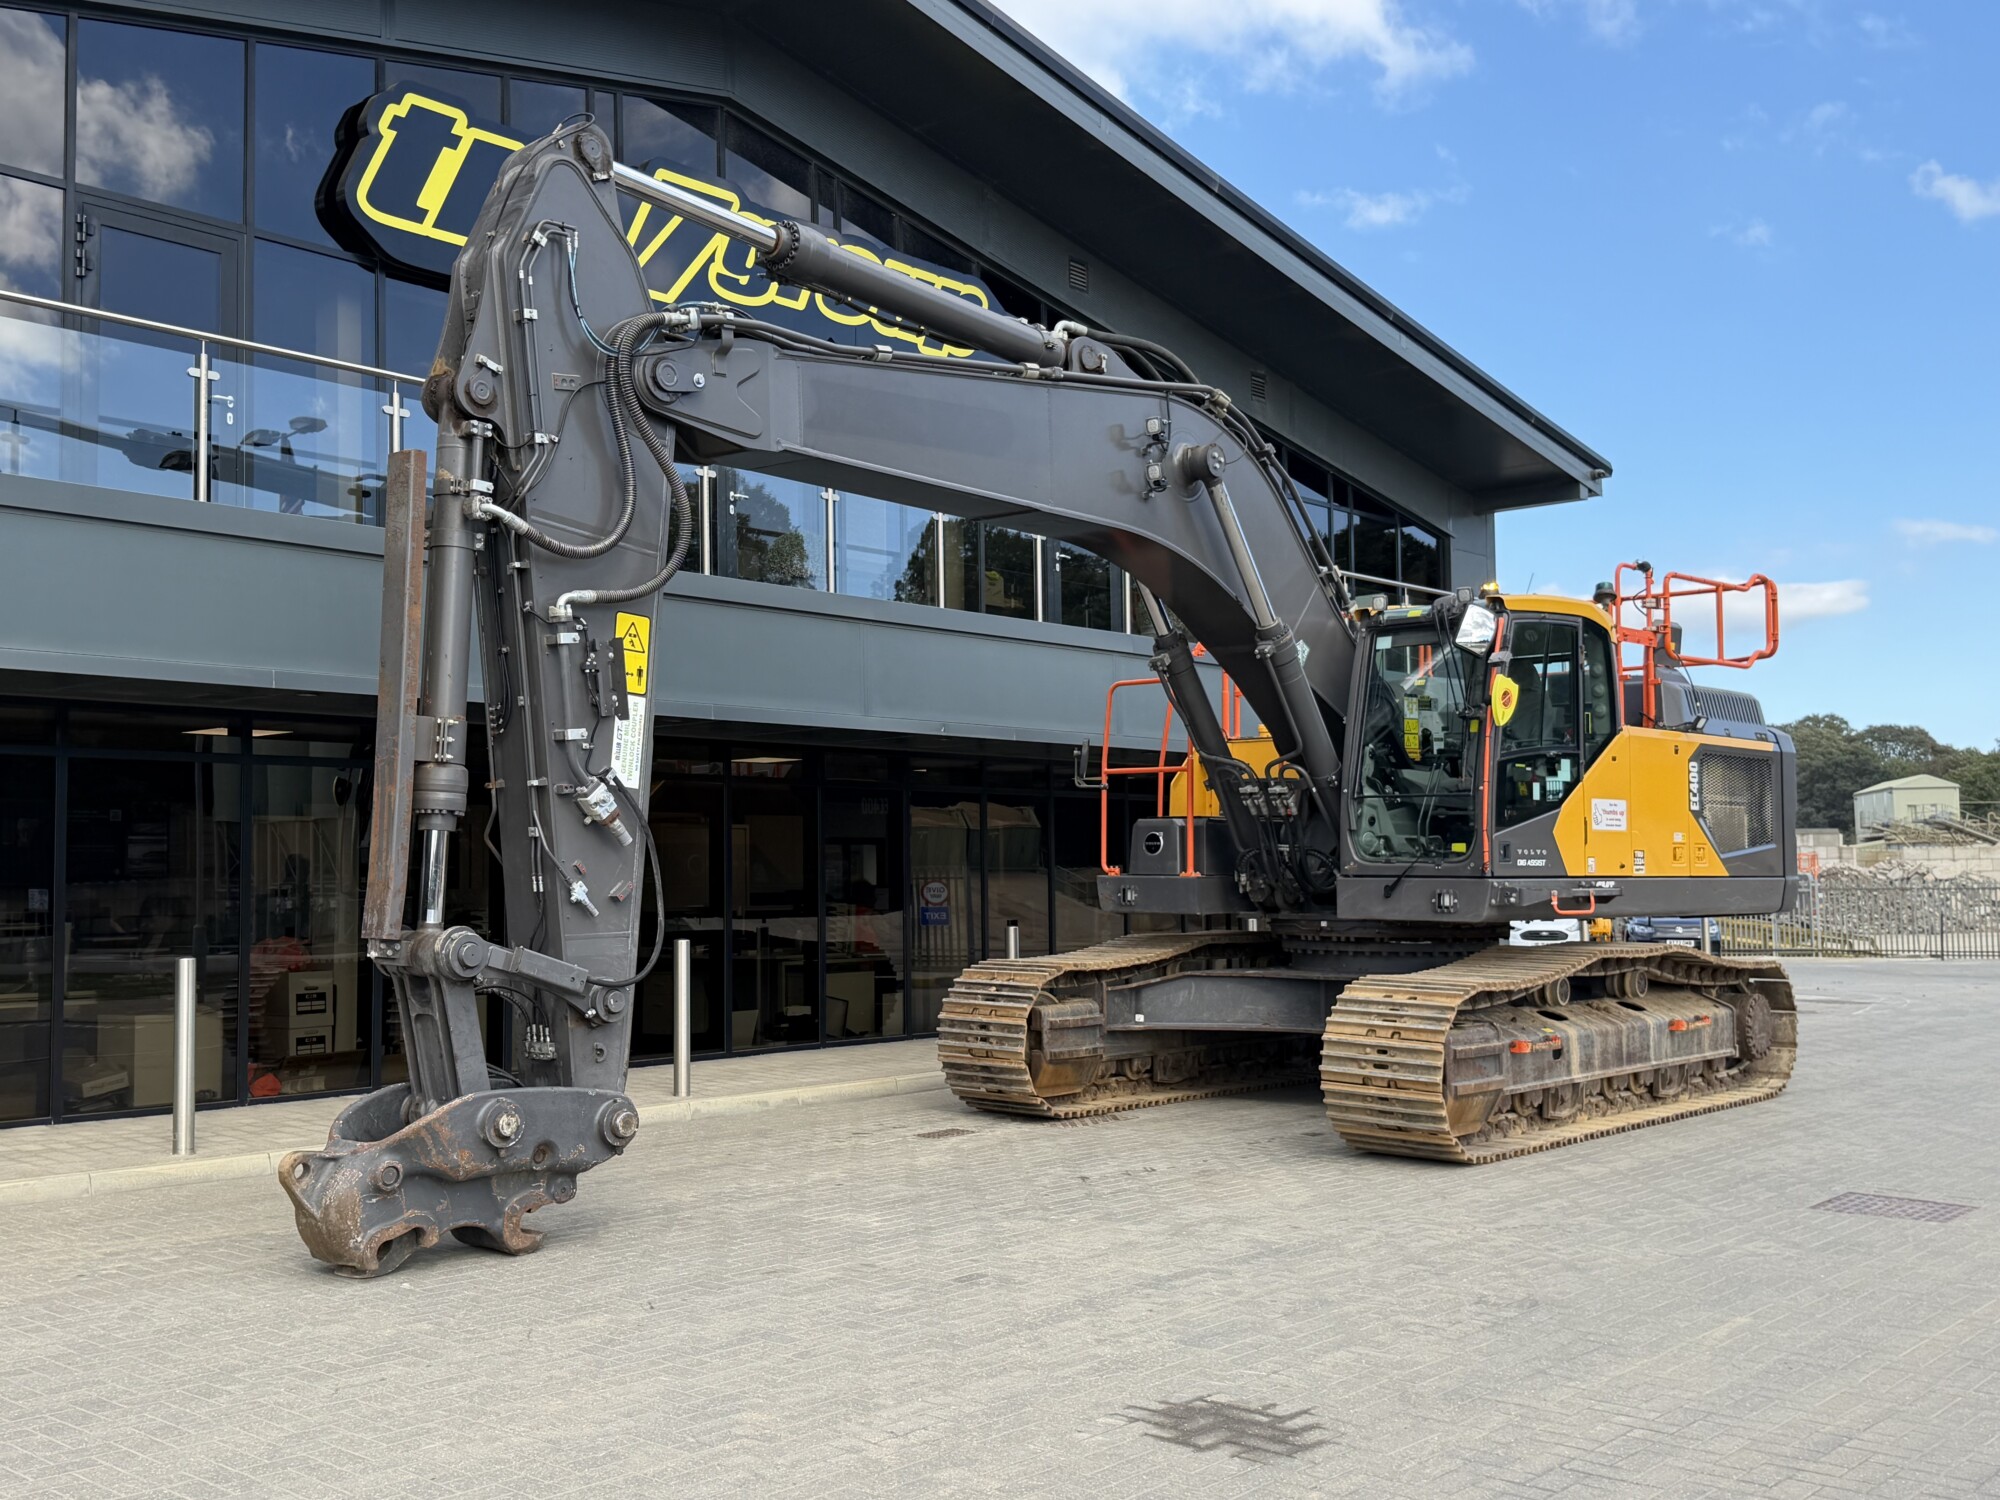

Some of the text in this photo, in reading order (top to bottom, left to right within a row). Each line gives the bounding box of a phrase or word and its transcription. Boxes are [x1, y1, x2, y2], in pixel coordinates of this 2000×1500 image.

[621, 740, 629, 774] GENUINE
[627, 701, 639, 782] TWINLOCK COUPLER
[1689, 761, 1700, 811] EC400
[1517, 859, 1547, 867] DIG ASSIST
